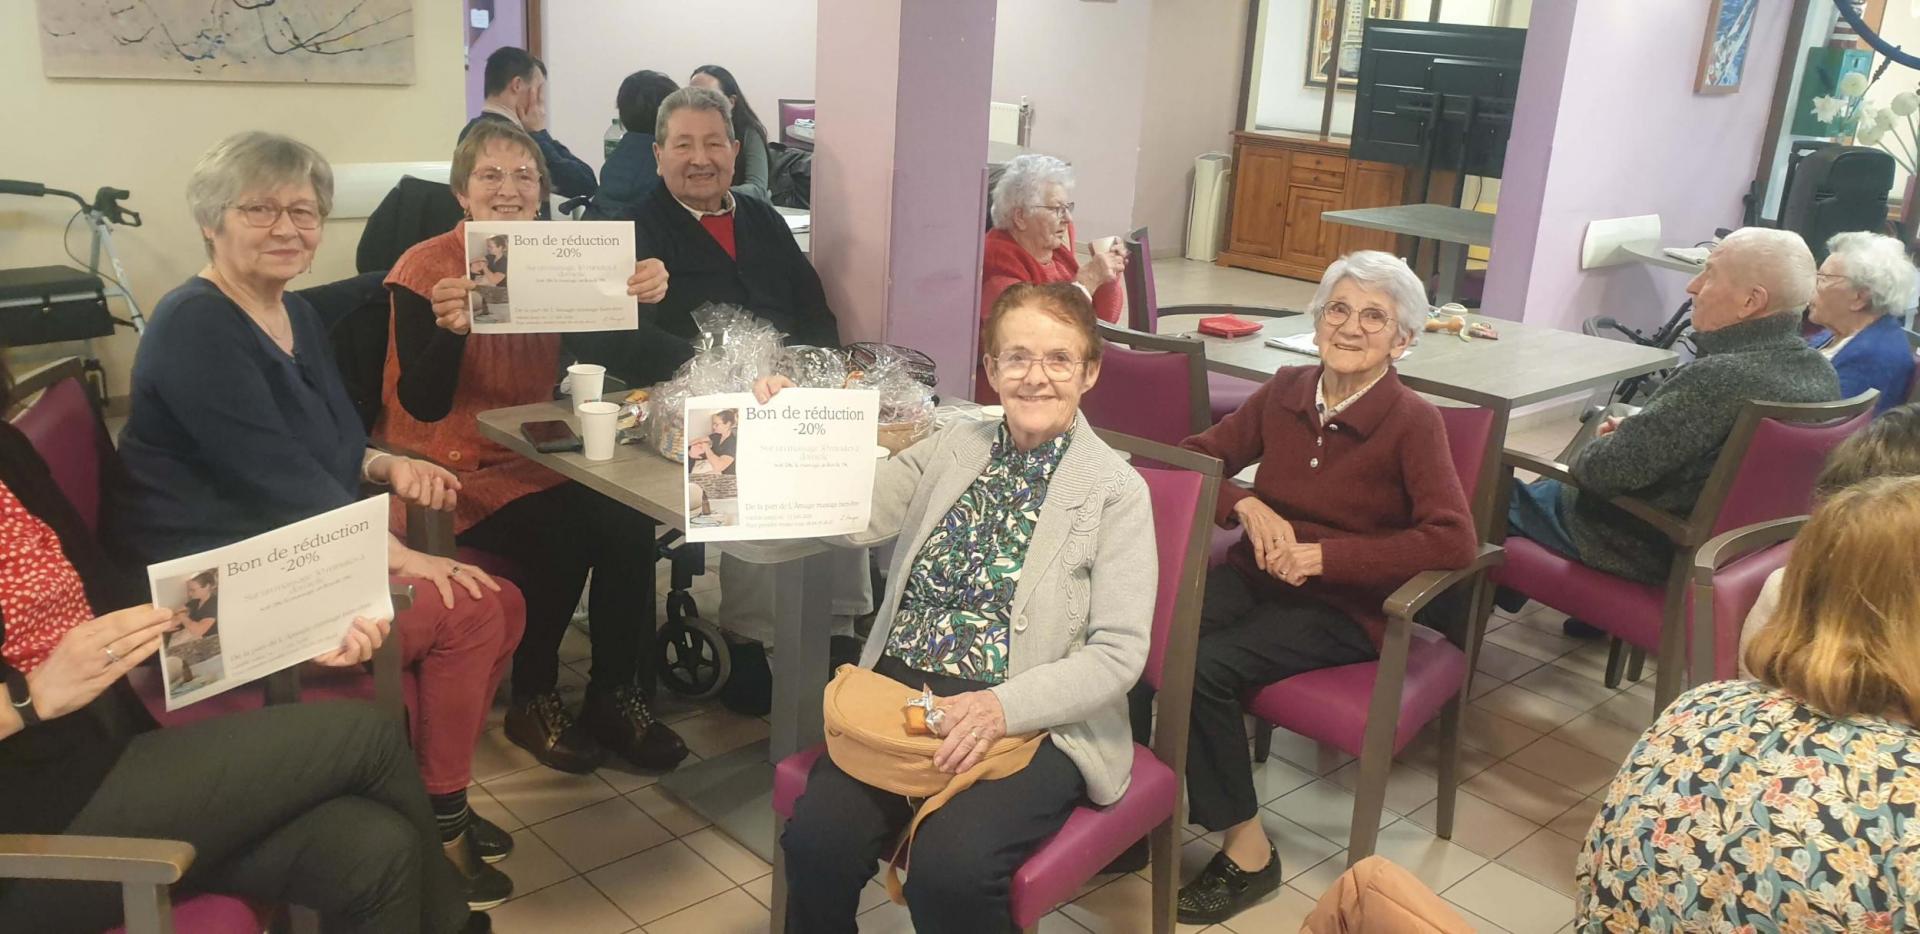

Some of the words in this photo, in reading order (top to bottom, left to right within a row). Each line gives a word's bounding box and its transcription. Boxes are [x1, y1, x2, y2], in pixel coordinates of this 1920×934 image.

[514, 235, 539, 246] Bon
[542, 234, 557, 246] de
[561, 234, 620, 246] réduction
[552, 248, 582, 258] -20%
[746, 407, 777, 420] Bon
[781, 405, 801, 420] de
[805, 406, 864, 421] réduction
[793, 422, 826, 435] -20%
[227, 556, 262, 577] Bon
[267, 548, 288, 563] de
[293, 520, 369, 555] réduction
[281, 551, 320, 573] -20%
